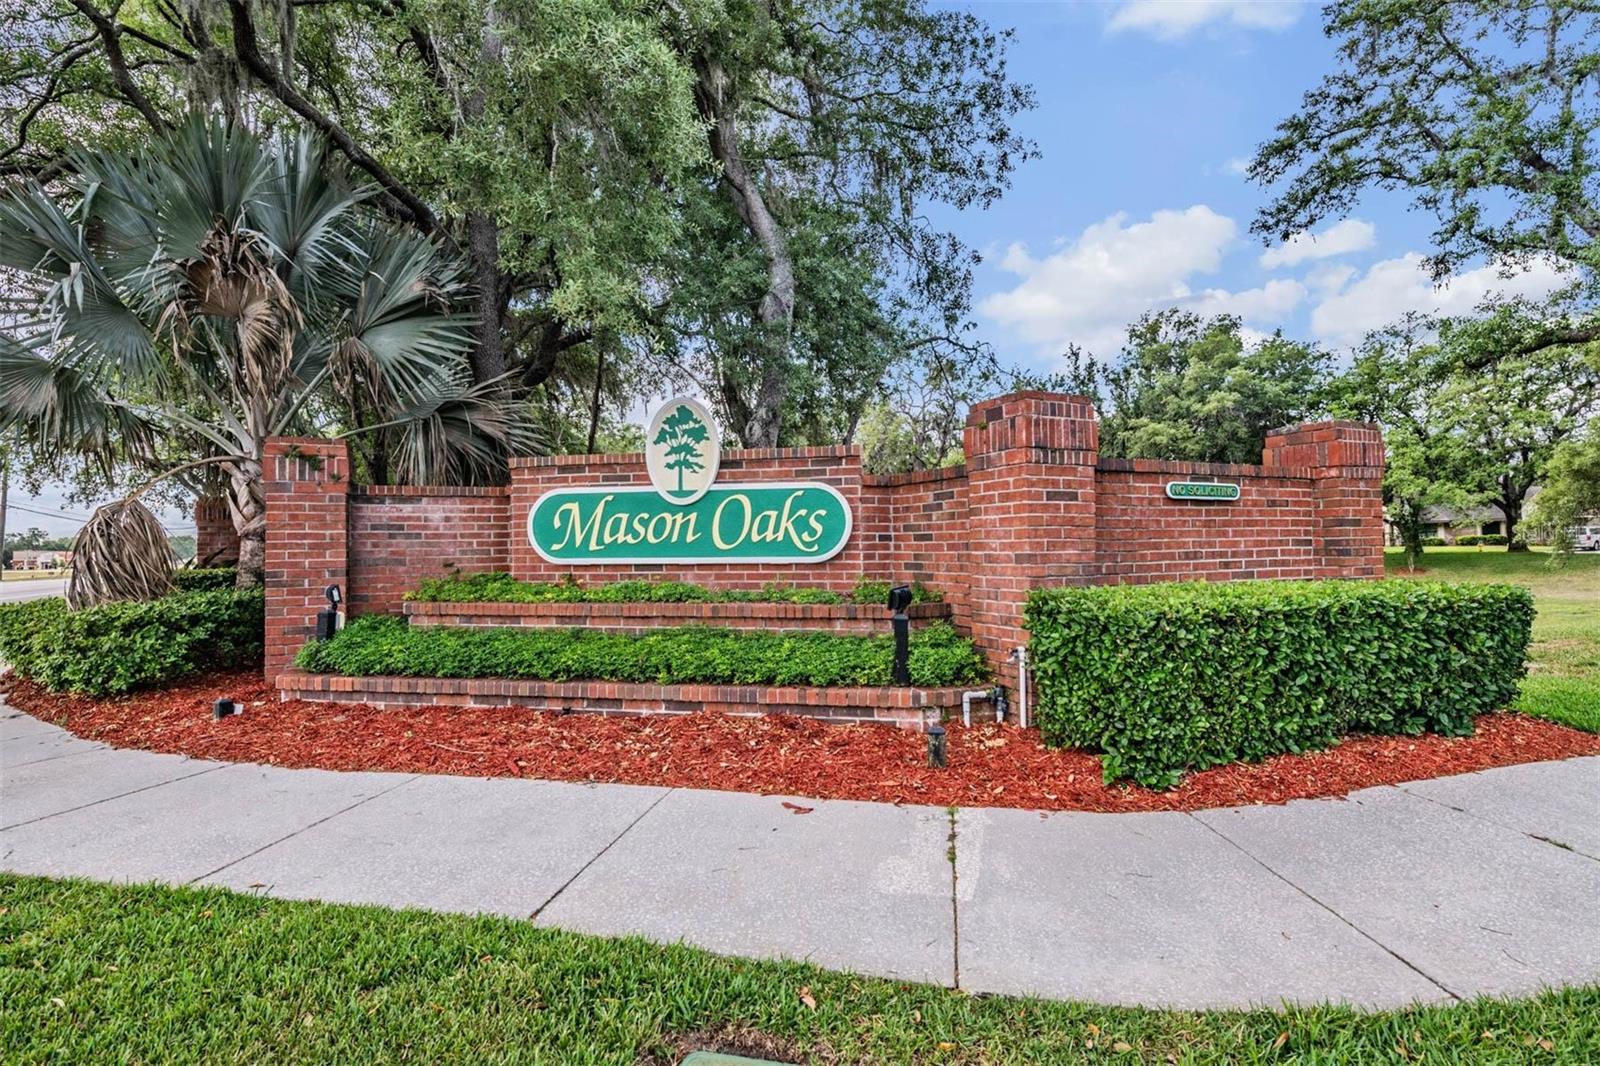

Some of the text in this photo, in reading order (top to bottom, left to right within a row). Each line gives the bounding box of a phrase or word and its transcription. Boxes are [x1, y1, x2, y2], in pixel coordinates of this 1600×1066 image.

[1172, 485, 1236, 496] NO SOLICITING
[550, 490, 827, 552] Mason Oaks
